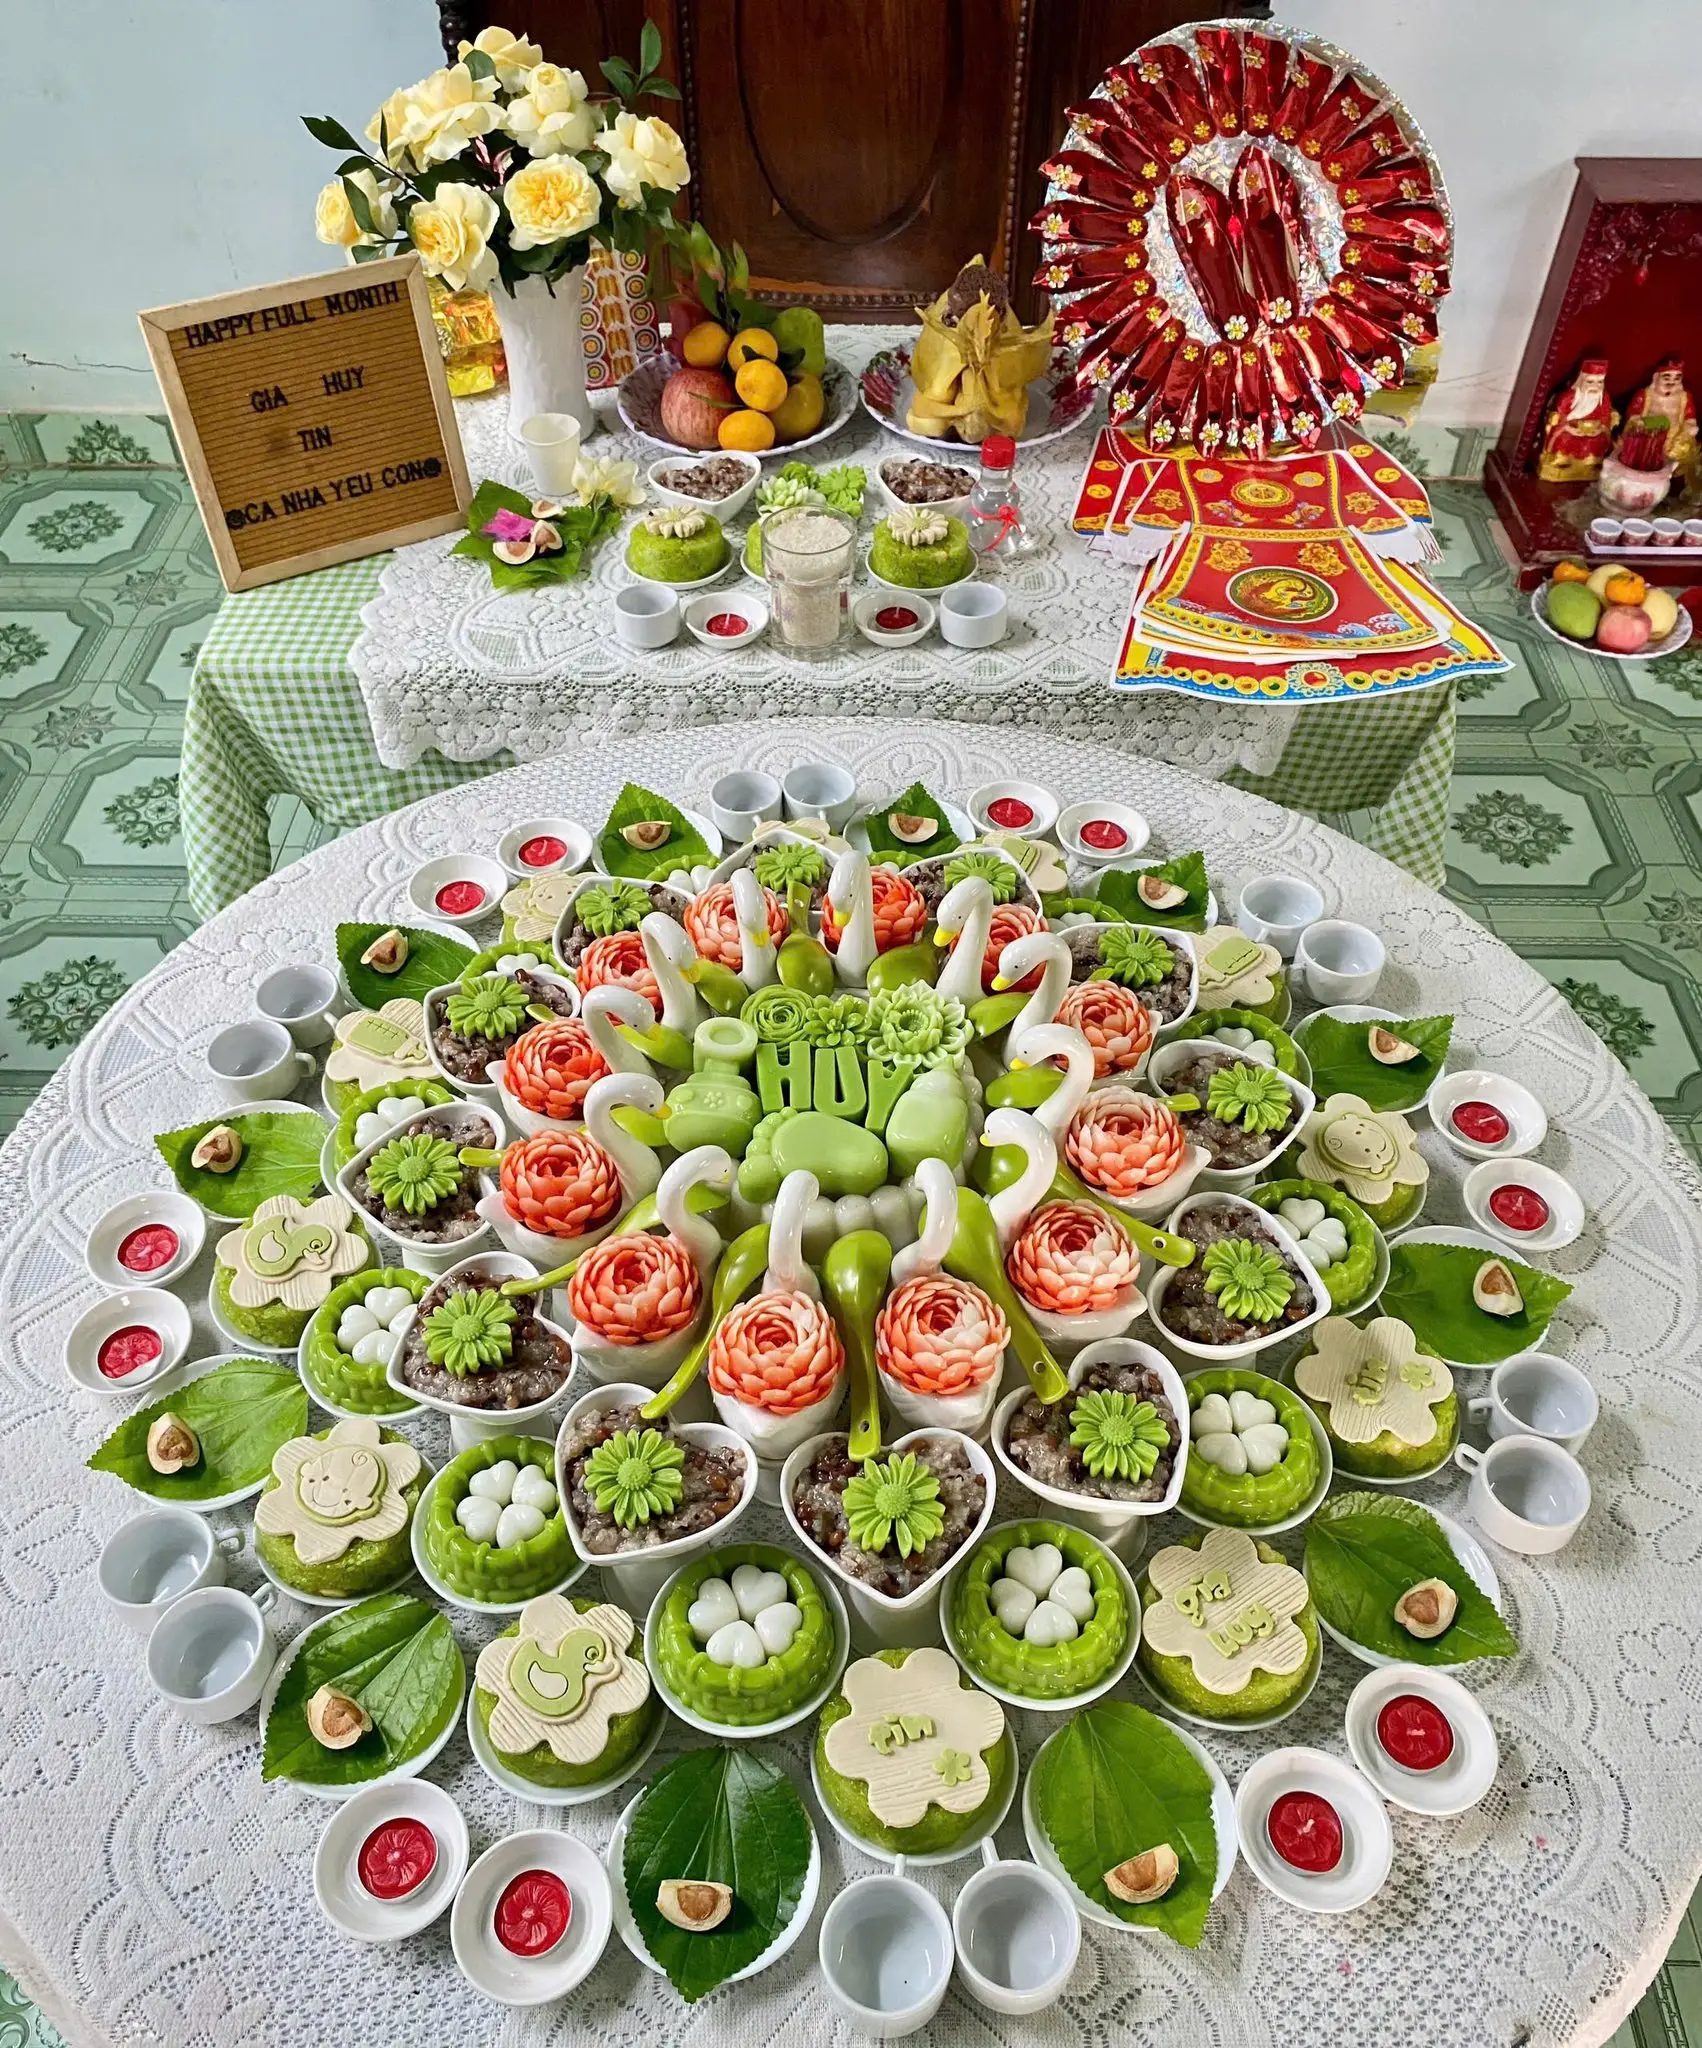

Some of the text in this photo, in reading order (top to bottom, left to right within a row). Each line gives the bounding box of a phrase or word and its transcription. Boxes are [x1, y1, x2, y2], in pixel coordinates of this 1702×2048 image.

[184, 282, 399, 348] HAPPY FULL MONTH
[250, 366, 364, 413] GIA HUY
[297, 426, 333, 452] TIN
[244, 461, 426, 524] CA NHA YEU CON
[756, 1041, 914, 1138] HUY
[1174, 1570, 1231, 1627] gia
